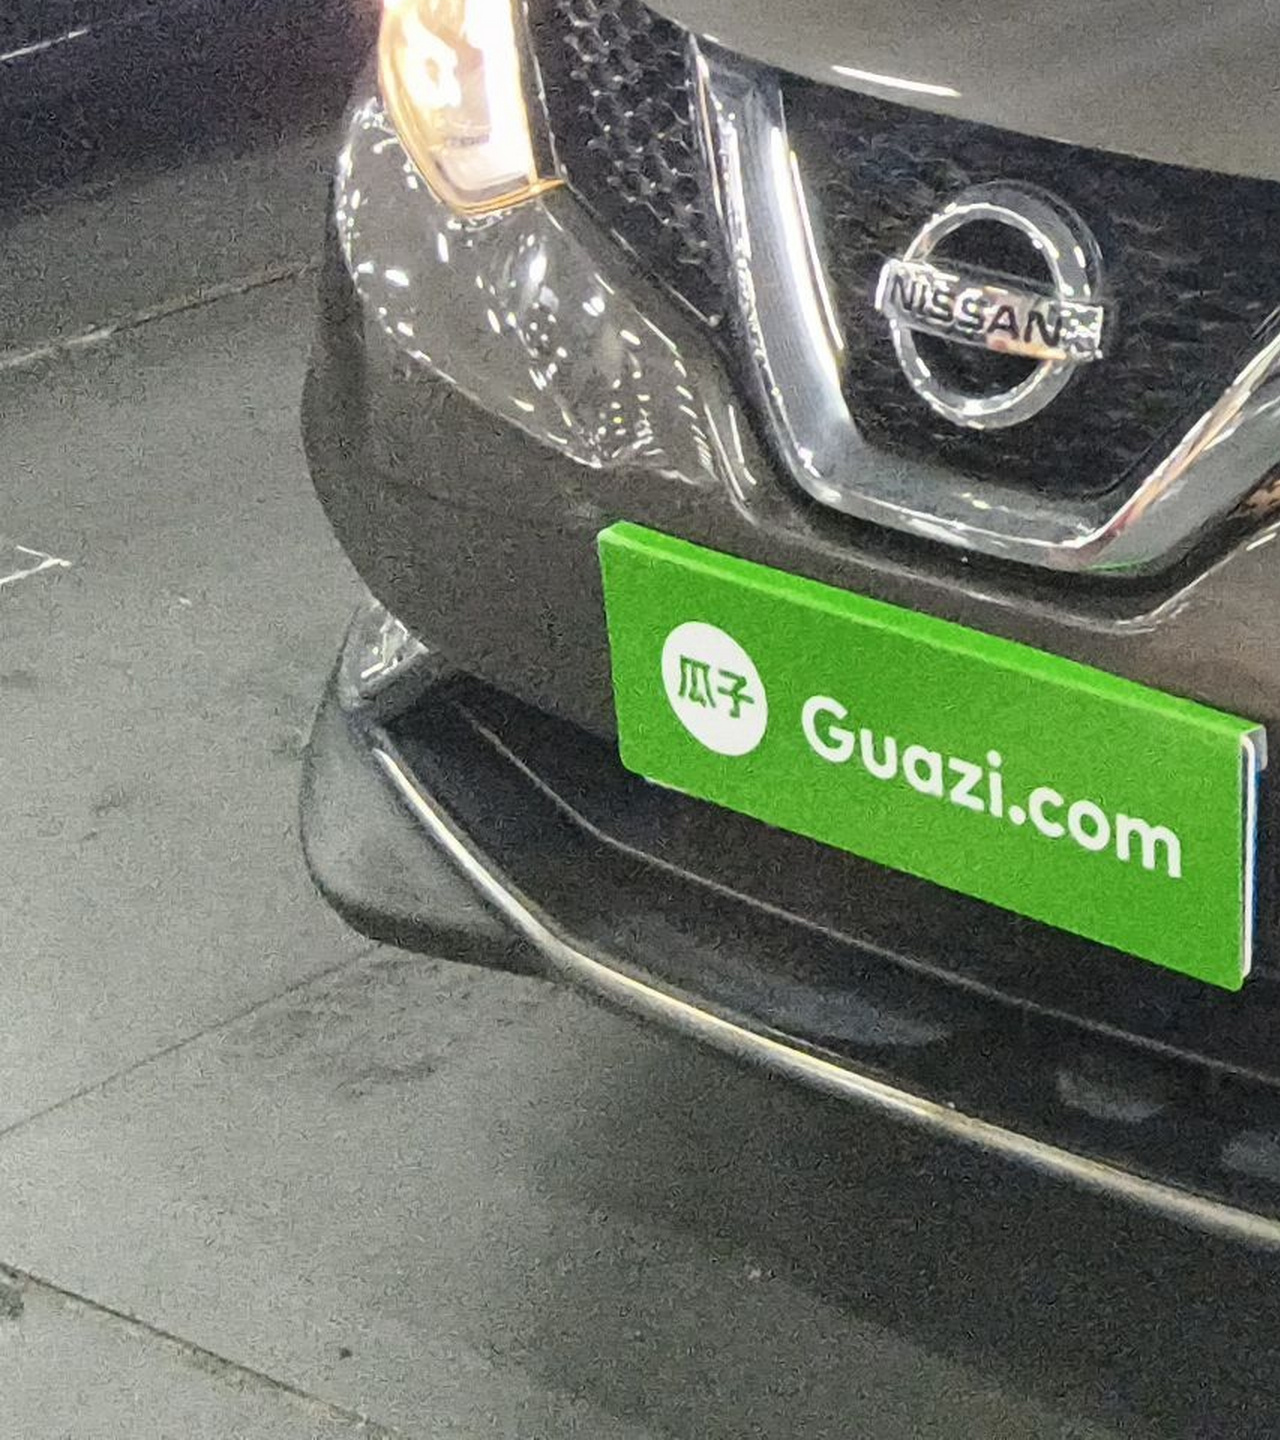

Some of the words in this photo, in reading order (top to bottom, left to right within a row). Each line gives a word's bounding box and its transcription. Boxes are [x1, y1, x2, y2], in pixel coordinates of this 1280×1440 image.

[889, 268, 1063, 348] NISSAN
[678, 655, 755, 719] 瓜子
[801, 695, 1182, 879] Guazi.com
